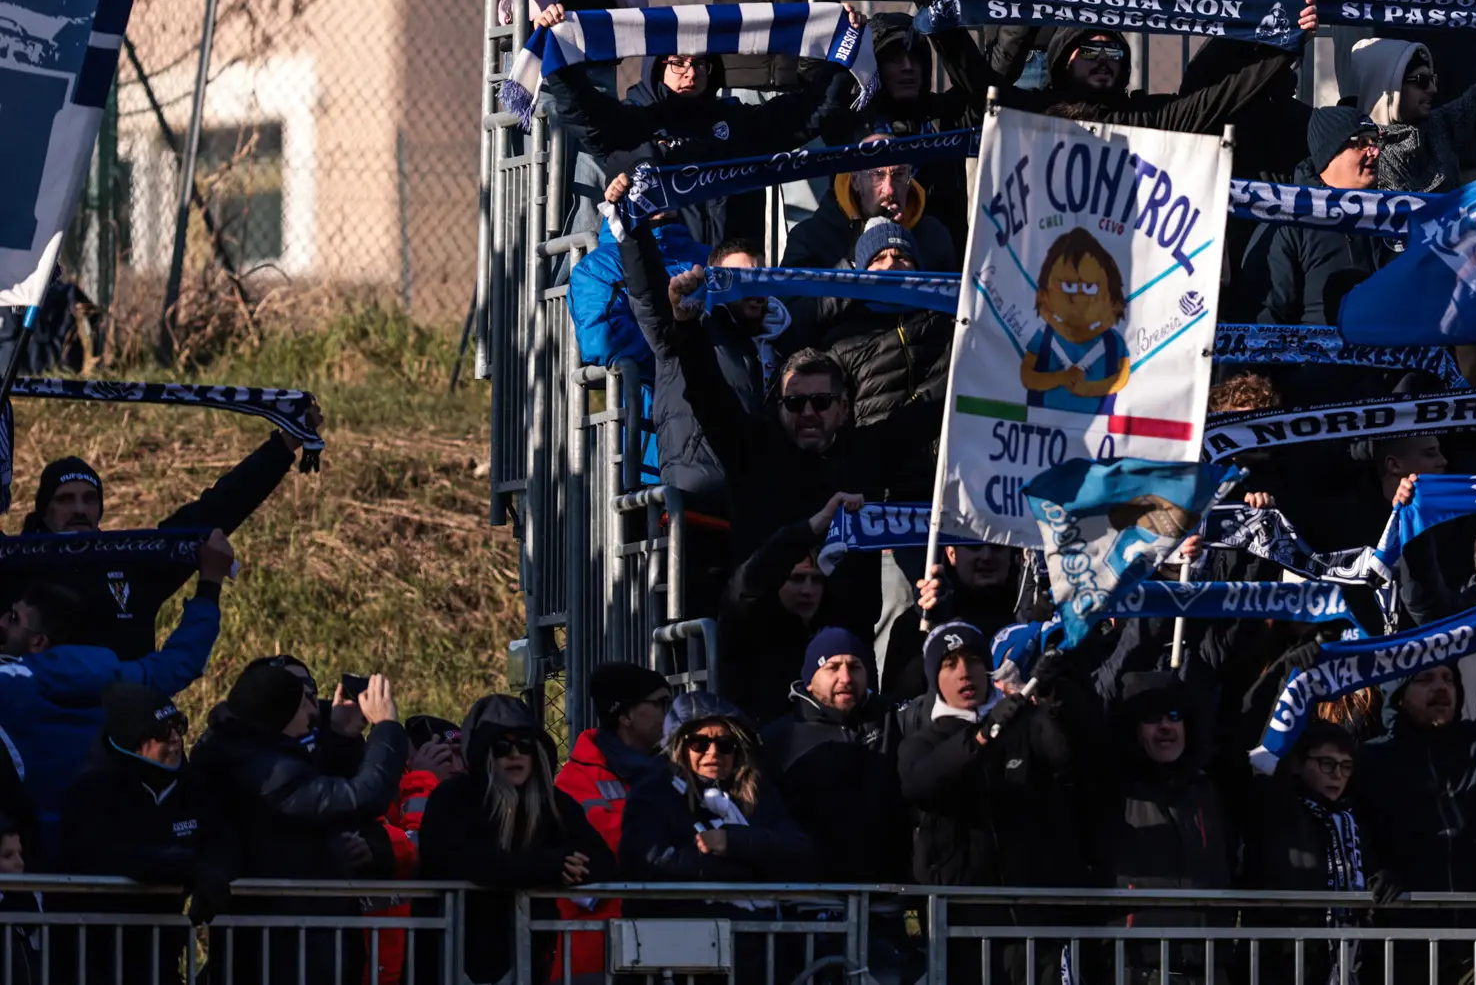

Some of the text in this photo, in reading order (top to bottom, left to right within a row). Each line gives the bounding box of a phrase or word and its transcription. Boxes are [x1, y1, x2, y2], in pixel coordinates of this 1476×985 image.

[987, 0, 1226, 37] SI PASSEGGIA
[1342, 2, 1372, 20] SI
[834, 26, 859, 63] BRESCI
[1044, 140, 1202, 277] CONTROL
[1134, 314, 1183, 357] Brescia
[989, 420, 1067, 467] SOTTO
[1247, 407, 1396, 444] NORD
[1369, 625, 1475, 678] NORD
